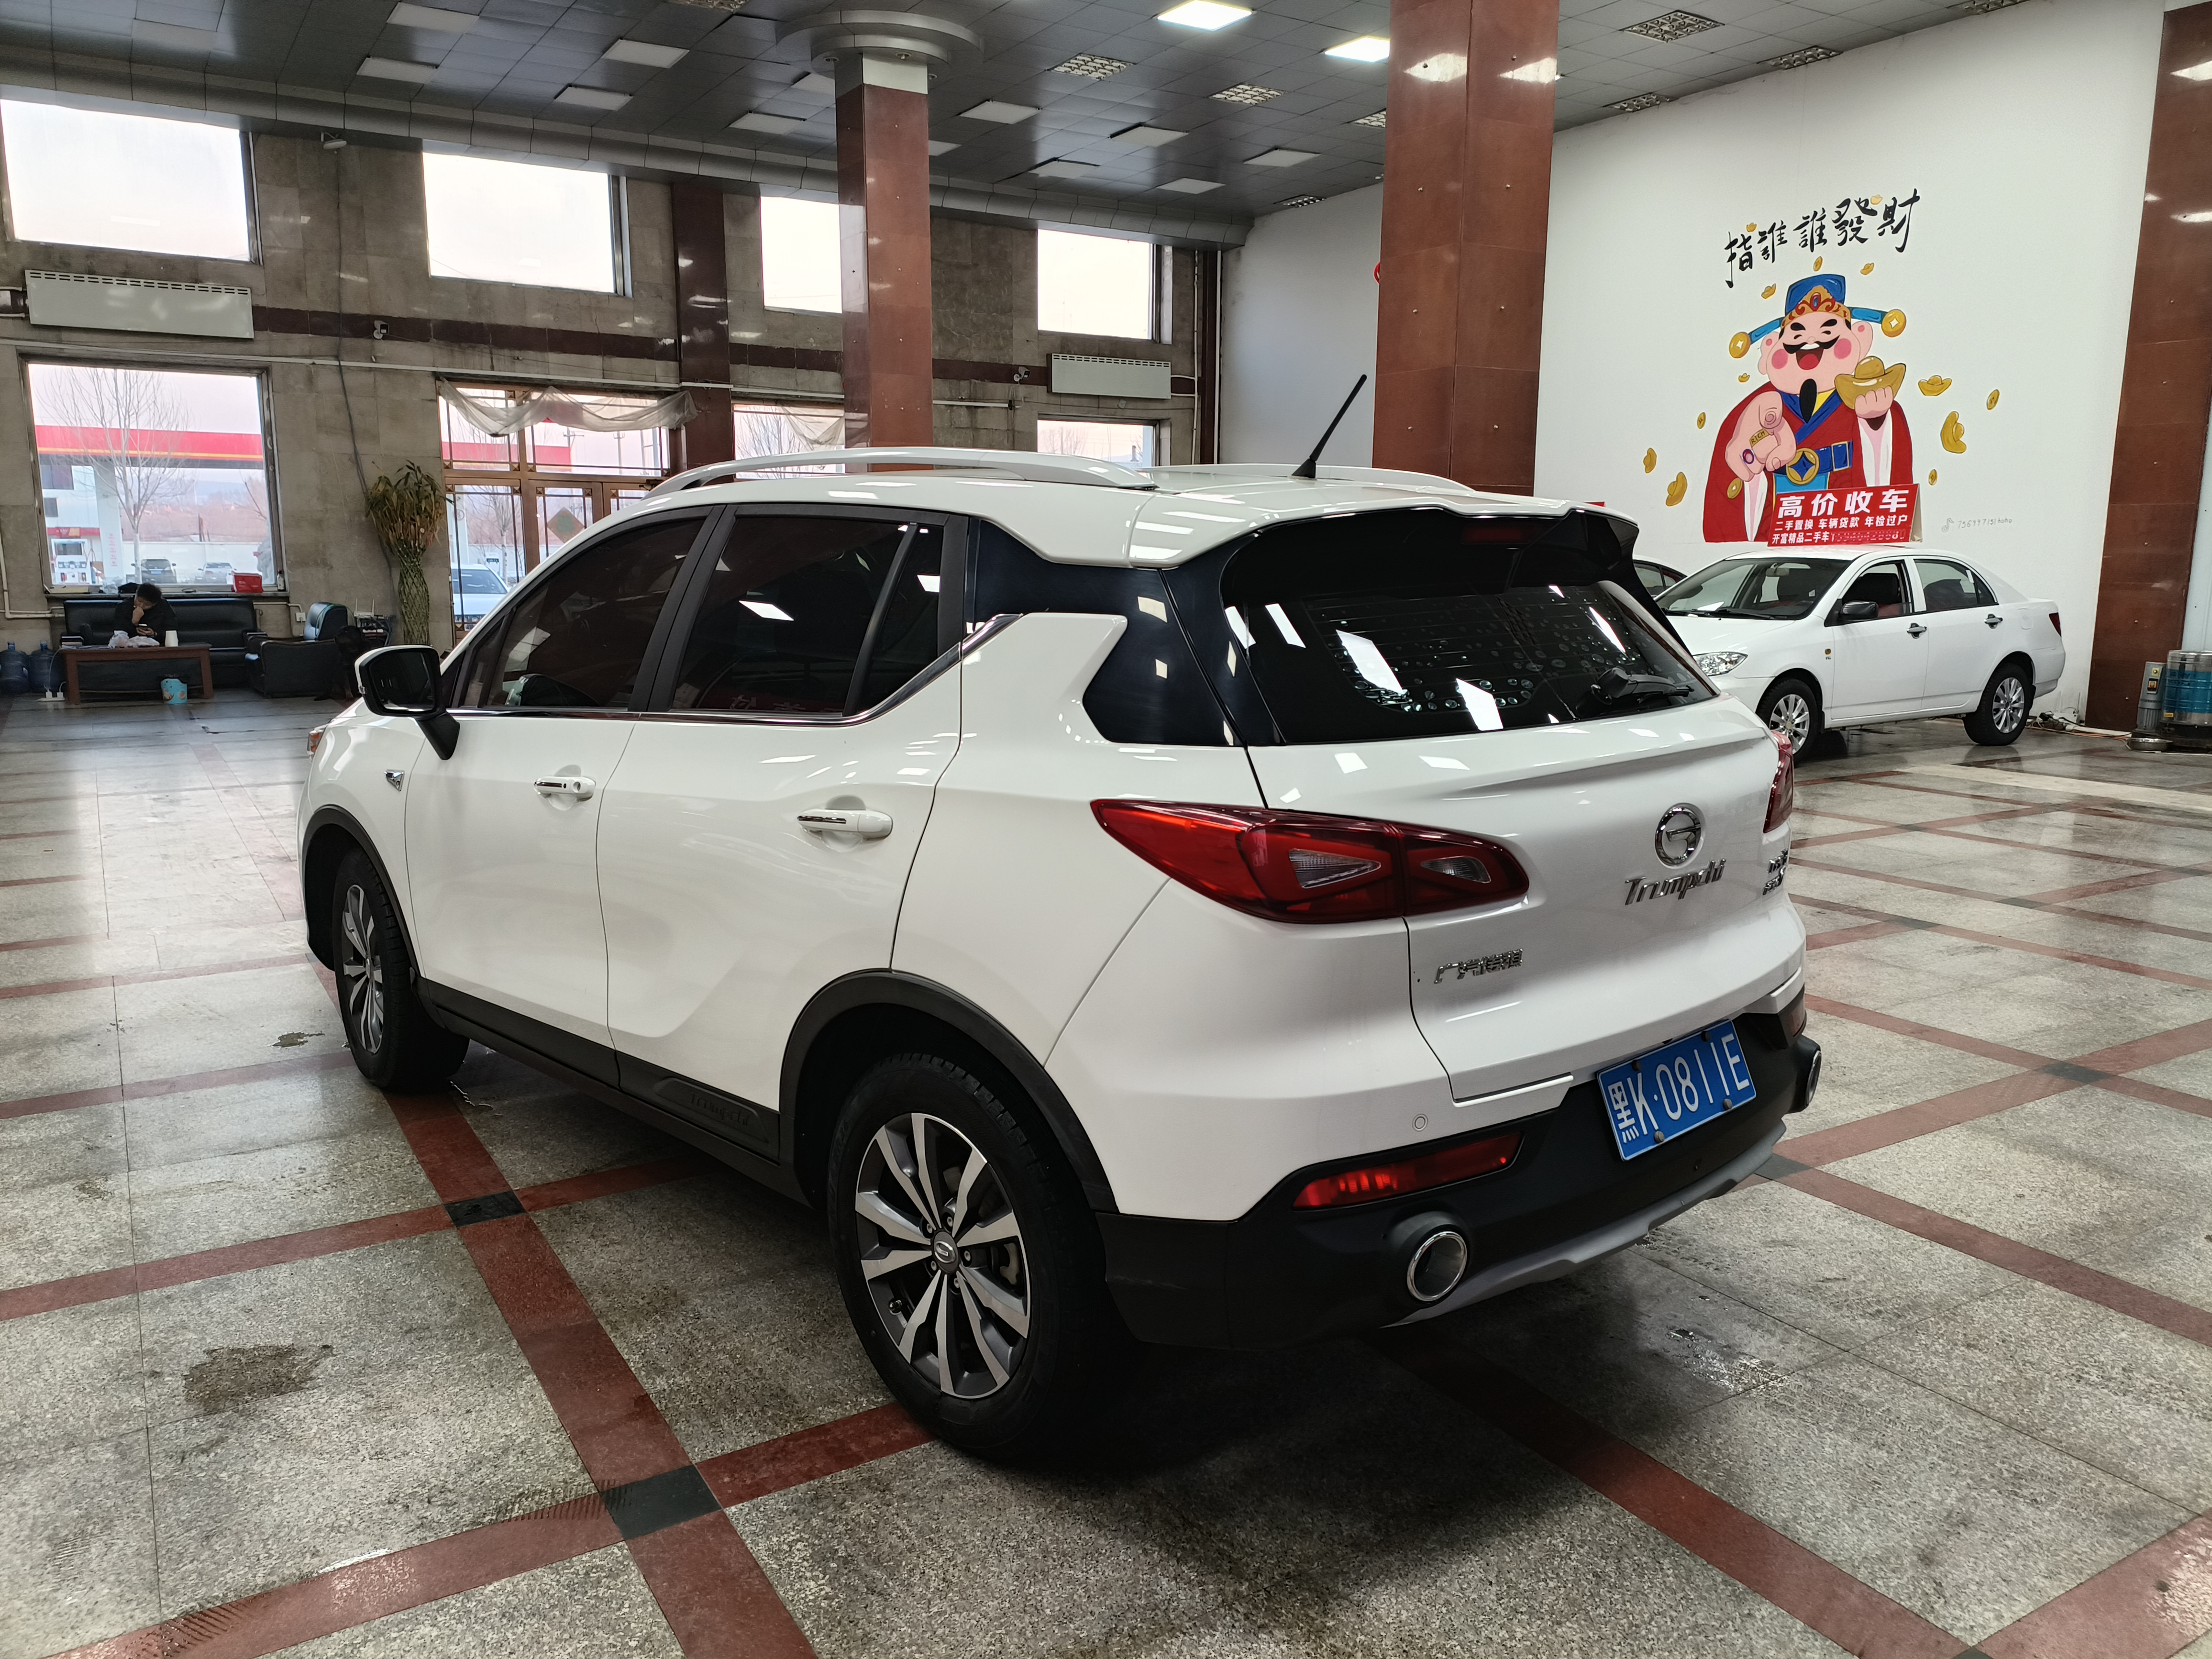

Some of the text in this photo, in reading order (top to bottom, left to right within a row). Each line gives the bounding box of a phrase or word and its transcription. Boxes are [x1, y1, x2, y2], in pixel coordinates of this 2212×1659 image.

[1750, 431, 1765, 444] RICH
[1778, 489, 1909, 518] 高价收车
[1774, 514, 1908, 531] 二手置换 车辆贷款 年检过户
[1771, 531, 1830, 544] 开富精品二手车
[1625, 858, 1726, 905] Trumpchi
